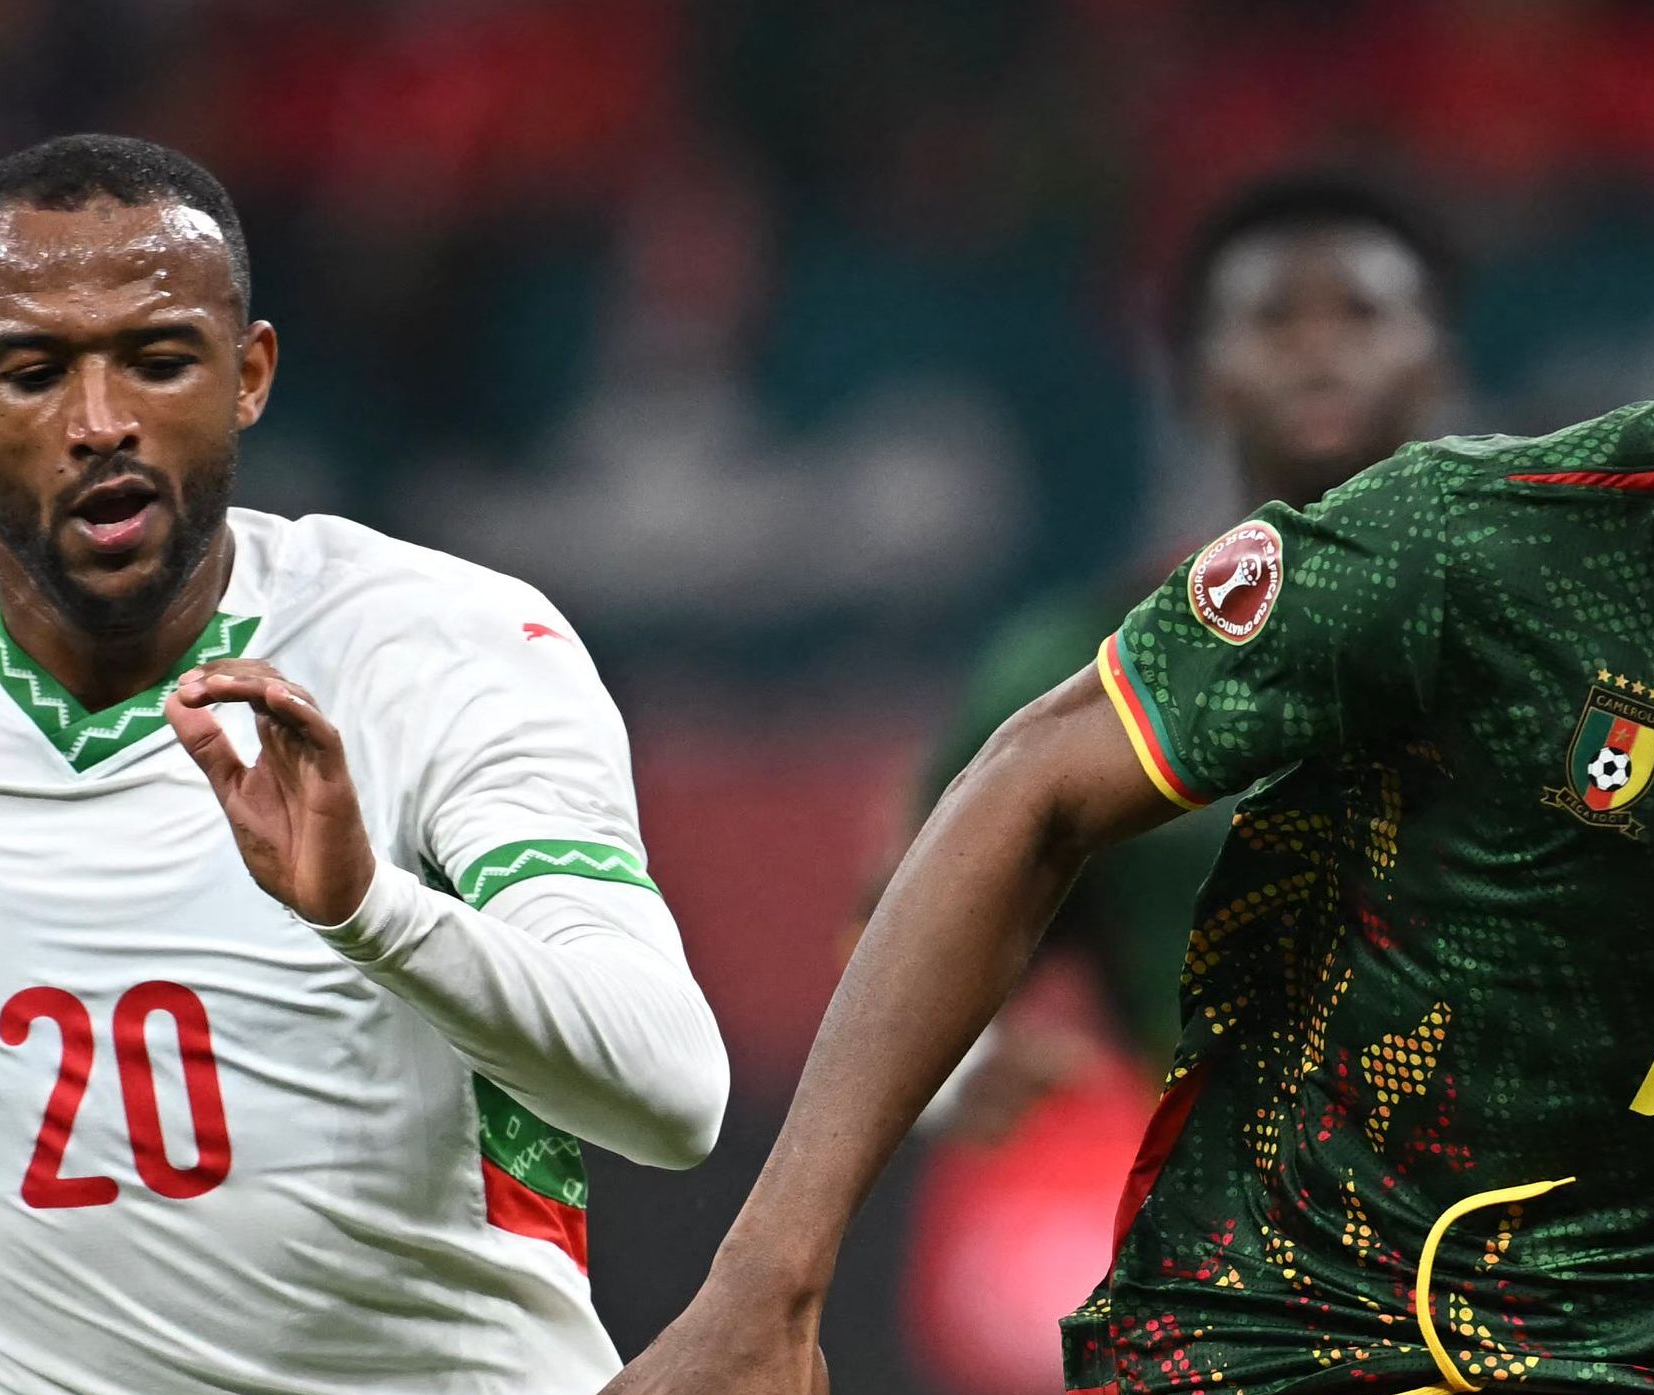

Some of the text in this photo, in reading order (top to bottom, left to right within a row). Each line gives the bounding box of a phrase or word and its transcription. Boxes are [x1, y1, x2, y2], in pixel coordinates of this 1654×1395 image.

[1238, 529, 1266, 541] CAF
[1194, 542, 1224, 608] MOROCCO
[1265, 555, 1278, 600] AFRICA
[1202, 606, 1244, 636] NATIONS
[1253, 601, 1268, 626] CUP
